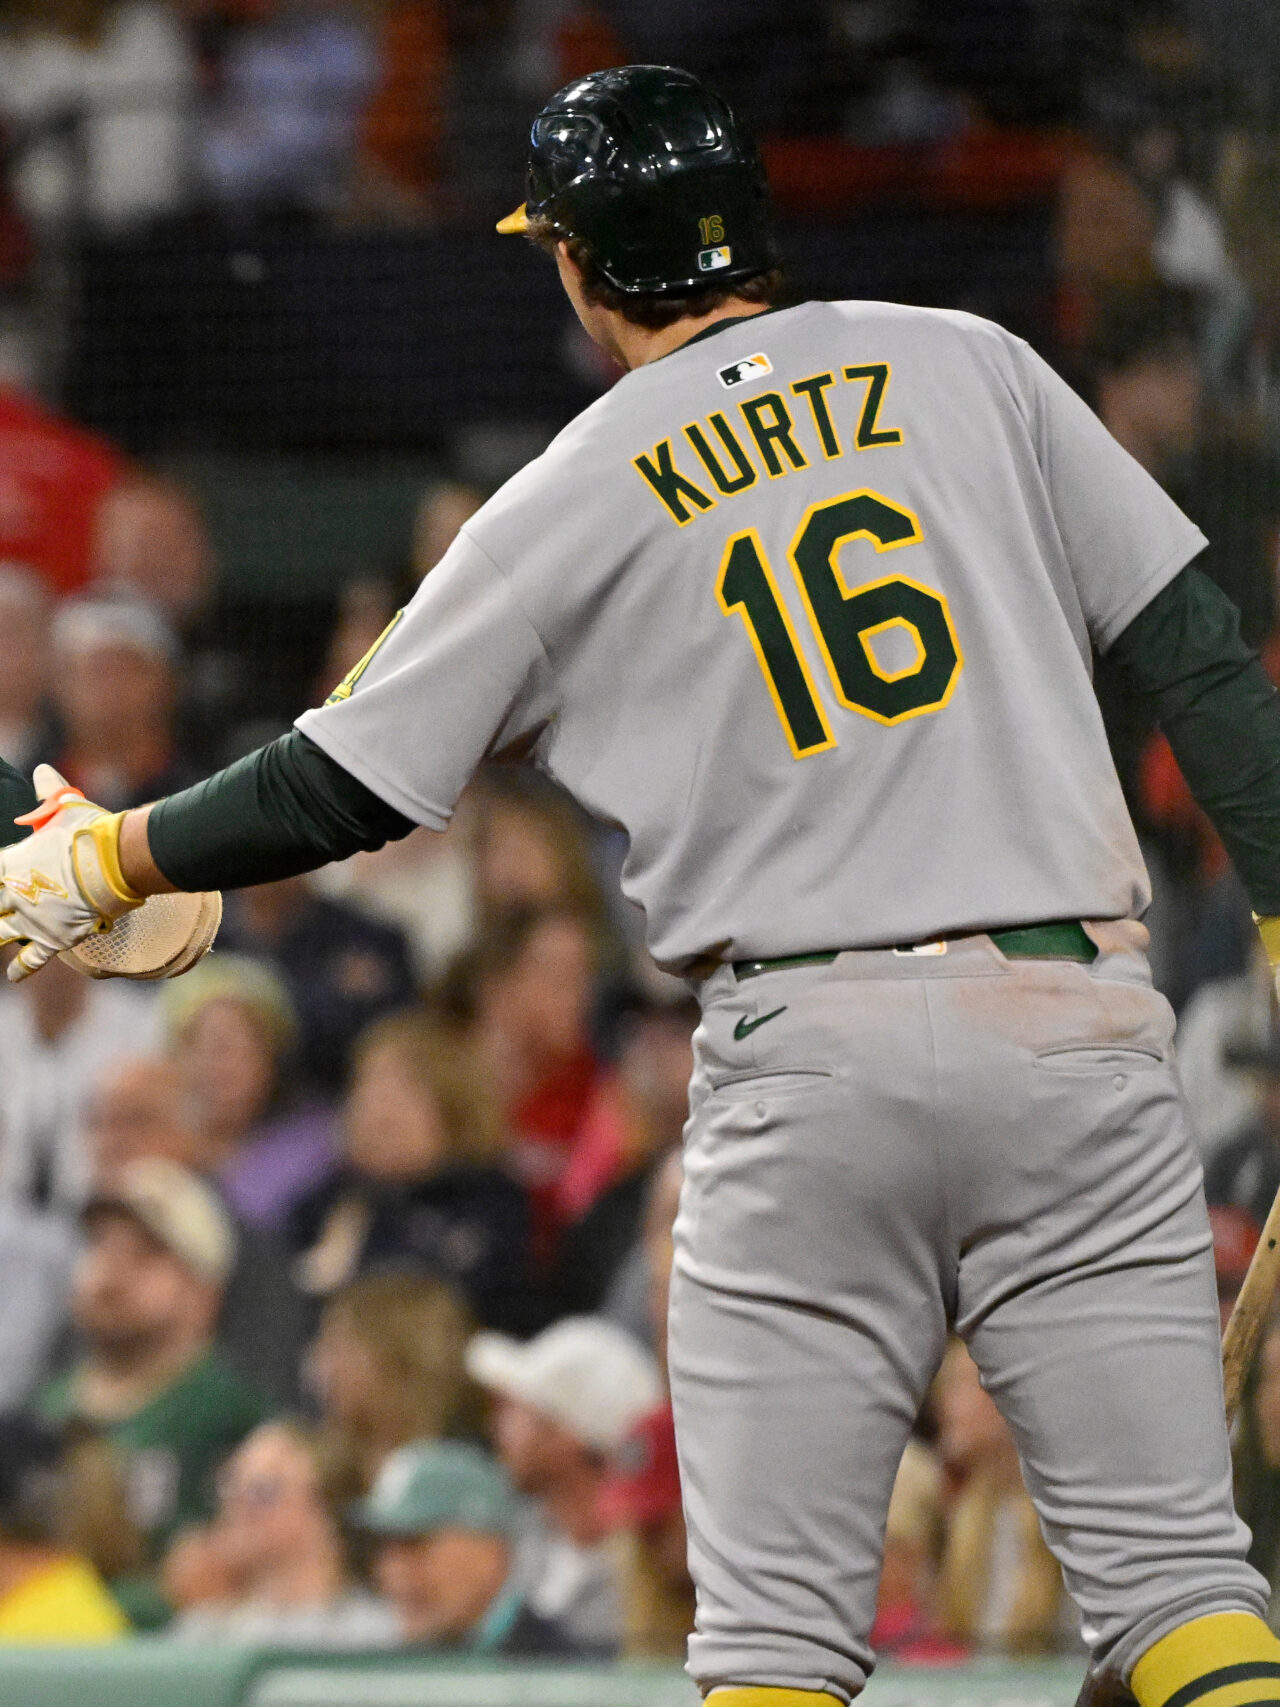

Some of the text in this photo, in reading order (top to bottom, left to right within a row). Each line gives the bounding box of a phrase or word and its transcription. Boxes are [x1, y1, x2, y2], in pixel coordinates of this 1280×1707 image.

[698, 215, 725, 245] 16
[630, 361, 904, 528] KURTZ
[713, 487, 965, 760] 16
